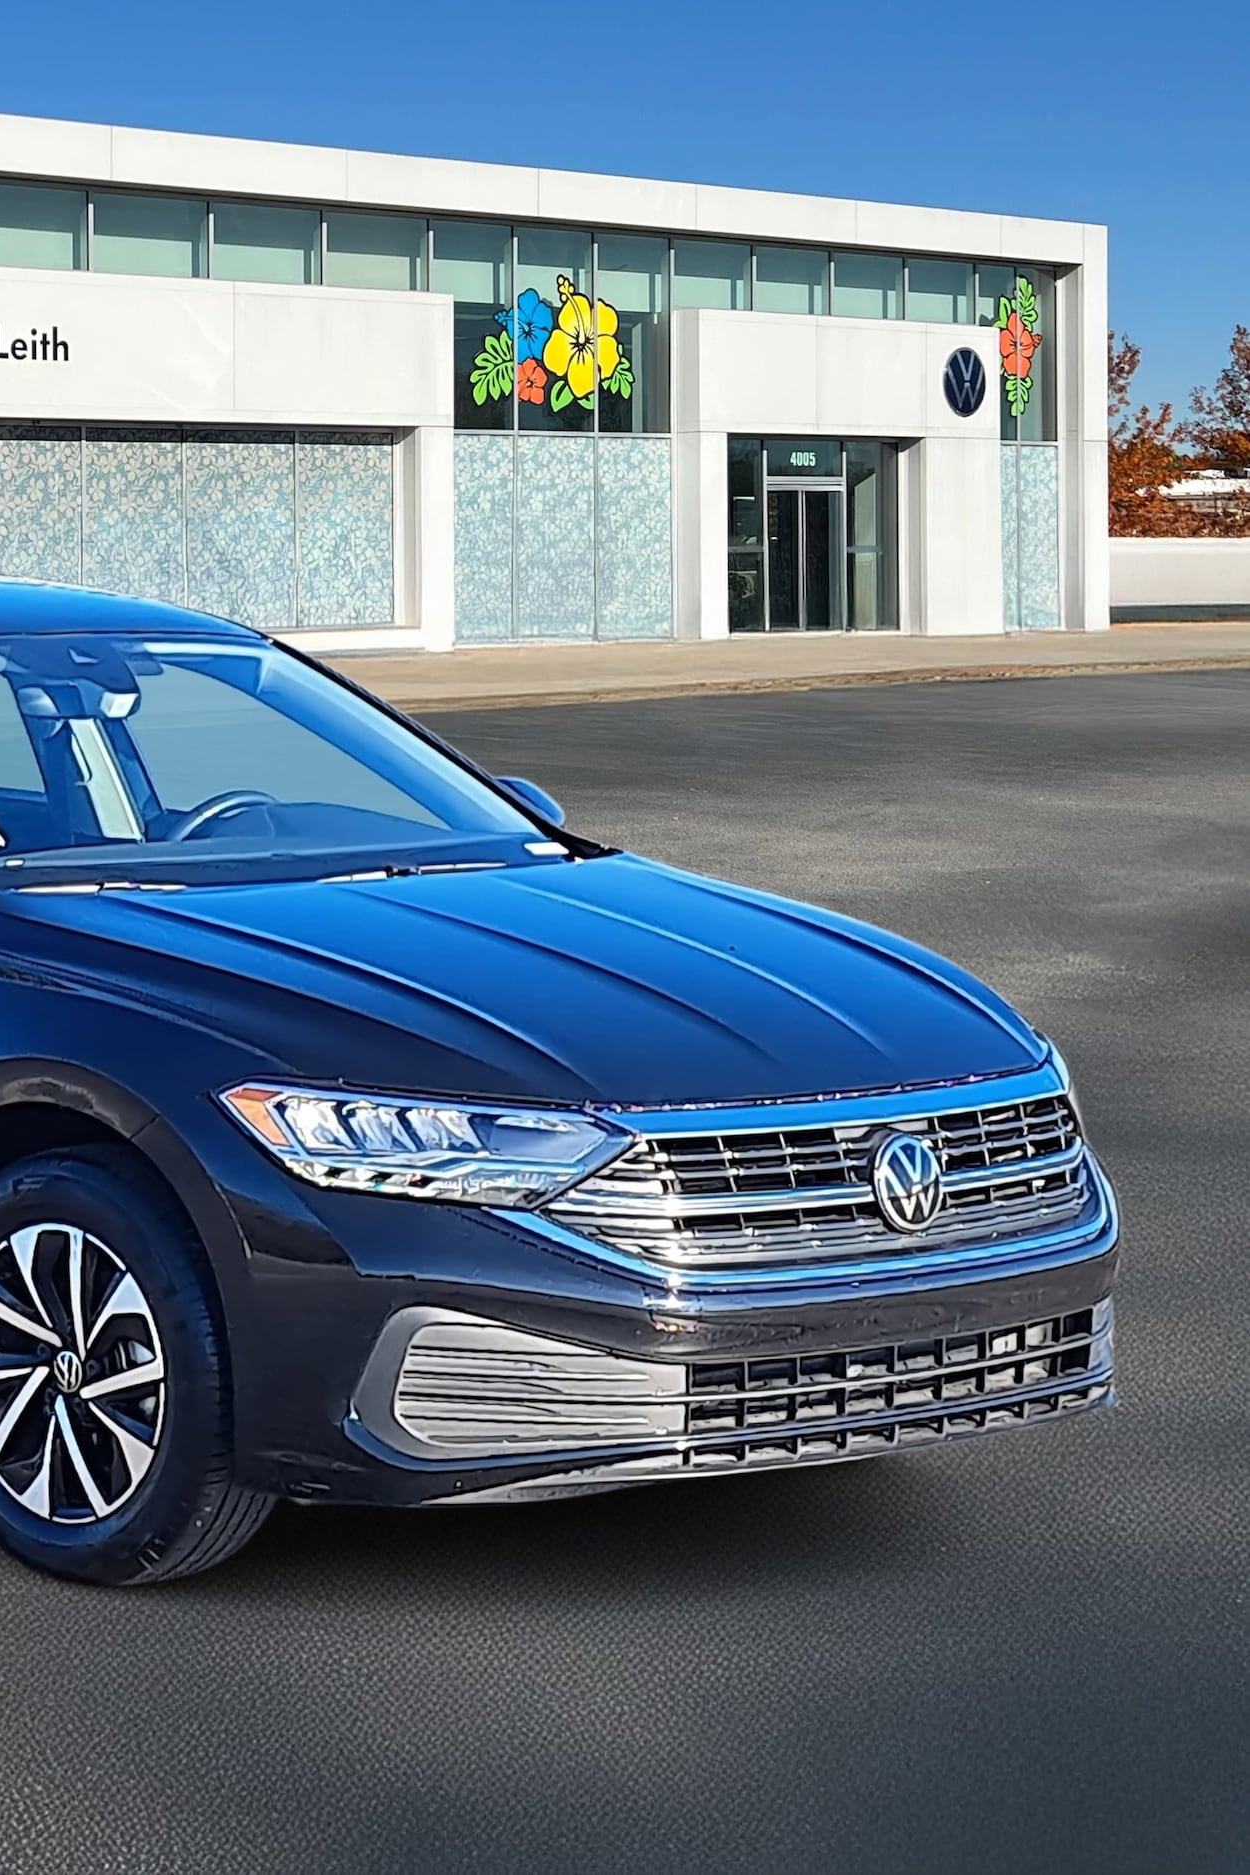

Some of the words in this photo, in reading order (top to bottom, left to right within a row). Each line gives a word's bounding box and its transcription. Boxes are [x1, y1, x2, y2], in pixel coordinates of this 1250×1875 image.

[946, 350, 985, 411] VW
[790, 451, 816, 467] 4005
[879, 1139, 938, 1225] VW
